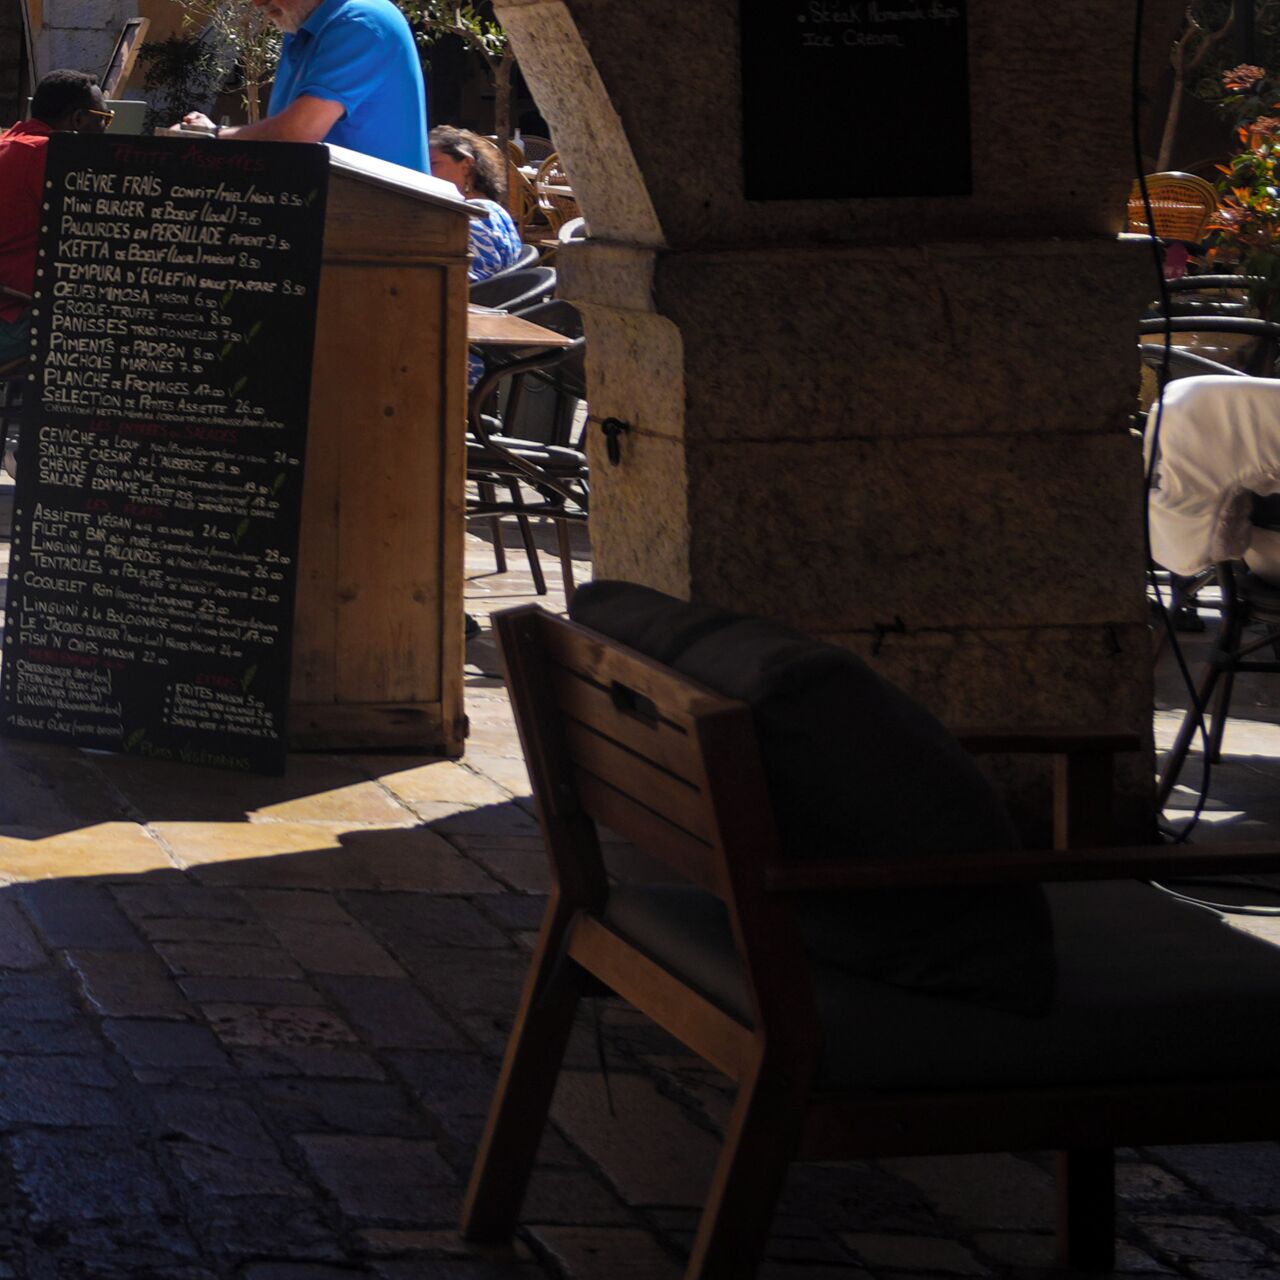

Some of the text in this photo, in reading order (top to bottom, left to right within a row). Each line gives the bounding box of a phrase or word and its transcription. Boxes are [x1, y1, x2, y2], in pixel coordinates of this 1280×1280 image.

[64, 168, 118, 195] CHÈVRE
[95, 198, 146, 220] BURGER
[60, 214, 131, 241] PALOURDES
[58, 239, 110, 261] KEFTA
[54, 262, 122, 285] TEMPURA
[99, 285, 150, 306] MIMOSA
[45, 351, 112, 371] ANCHOIS
[43, 368, 111, 390] PLANCHE
[123, 374, 190, 397] FROMAGES
[40, 442, 86, 460] SALADE
[90, 448, 134, 465] CAESAR
[39, 471, 86, 489] SALADE
[33, 503, 92, 525] ASSIETTE
[23, 571, 89, 594] COQUELET
